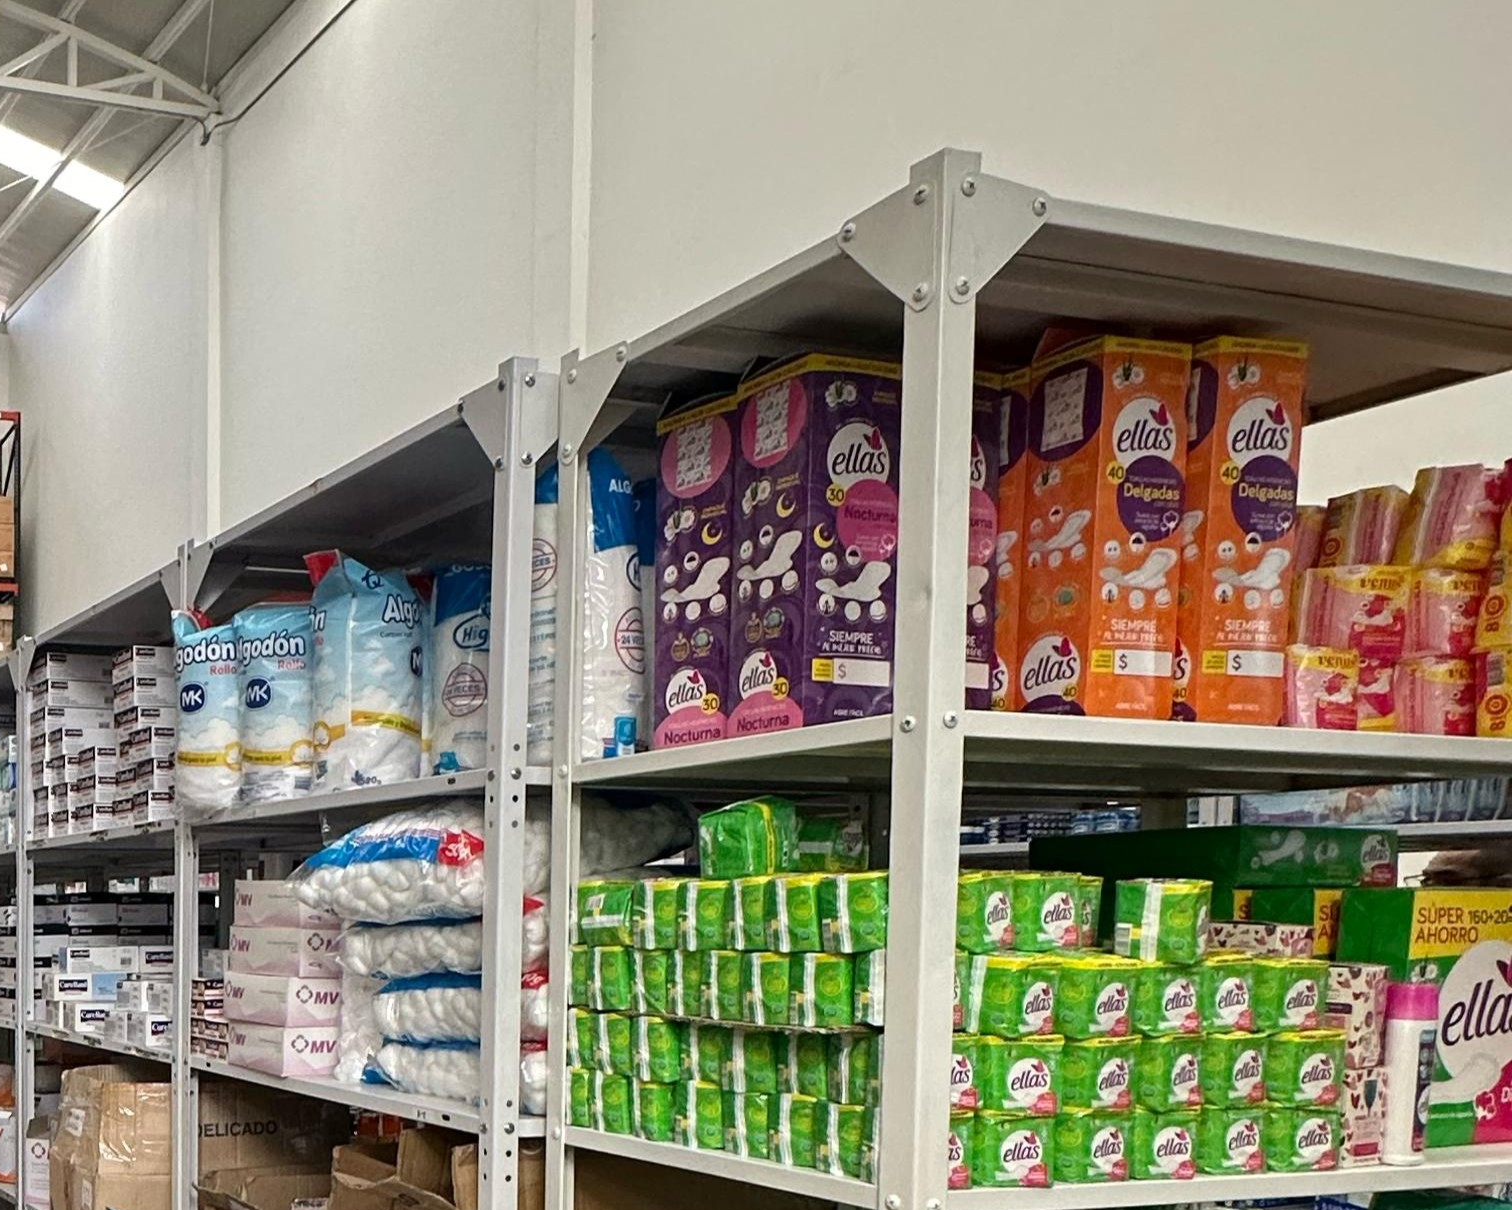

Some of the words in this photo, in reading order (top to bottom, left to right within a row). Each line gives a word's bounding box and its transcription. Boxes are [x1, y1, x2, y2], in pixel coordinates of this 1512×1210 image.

[1117, 421, 1173, 453] ellas
[1232, 421, 1289, 453] ellas
[831, 444, 887, 476] ellas
[1108, 465, 1125, 479] 40
[1222, 465, 1239, 479] 40
[828, 488, 845, 503] 30
[1124, 482, 1180, 502] Delgadas
[1238, 482, 1294, 502] Delgadas
[1110, 618, 1158, 632] SIEMPRE
[1224, 618, 1271, 632] SIEMPRE
[829, 629, 874, 645] SIEMPRE
[741, 664, 775, 694] ellas
[1024, 654, 1078, 691] ellas
[181, 690, 204, 707] MK
[247, 685, 270, 703] MK
[668, 679, 705, 710] ellas
[773, 681, 789, 696] 30
[703, 697, 719, 711] 30
[736, 713, 790, 732] Nocturna
[664, 726, 722, 746] Nocturna
[987, 904, 1009, 924] ellas
[1043, 903, 1073, 924] ellas
[1414, 925, 1479, 945] AHORRO
[314, 991, 340, 1006] MV
[1024, 992, 1052, 1015] ellas
[1097, 993, 1126, 1016] ellas
[1165, 990, 1193, 1012] ellas
[1218, 986, 1247, 1009] ellas
[1286, 987, 1316, 1010] ellas
[1442, 978, 1512, 1047] ella
[310, 1039, 337, 1055] MV
[951, 1065, 971, 1085] las
[1011, 1067, 1048, 1091] ellas
[1099, 1069, 1126, 1091] ellas
[1173, 1064, 1198, 1086] ellas
[1234, 1057, 1262, 1082] ellas
[1301, 1060, 1333, 1084] ellas
[1093, 1138, 1122, 1159] ellas
[1156, 1136, 1189, 1158] ellas
[1228, 1128, 1258, 1151] ellas
[1298, 1127, 1330, 1149] ellas
[1003, 1140, 1040, 1163] ellas
